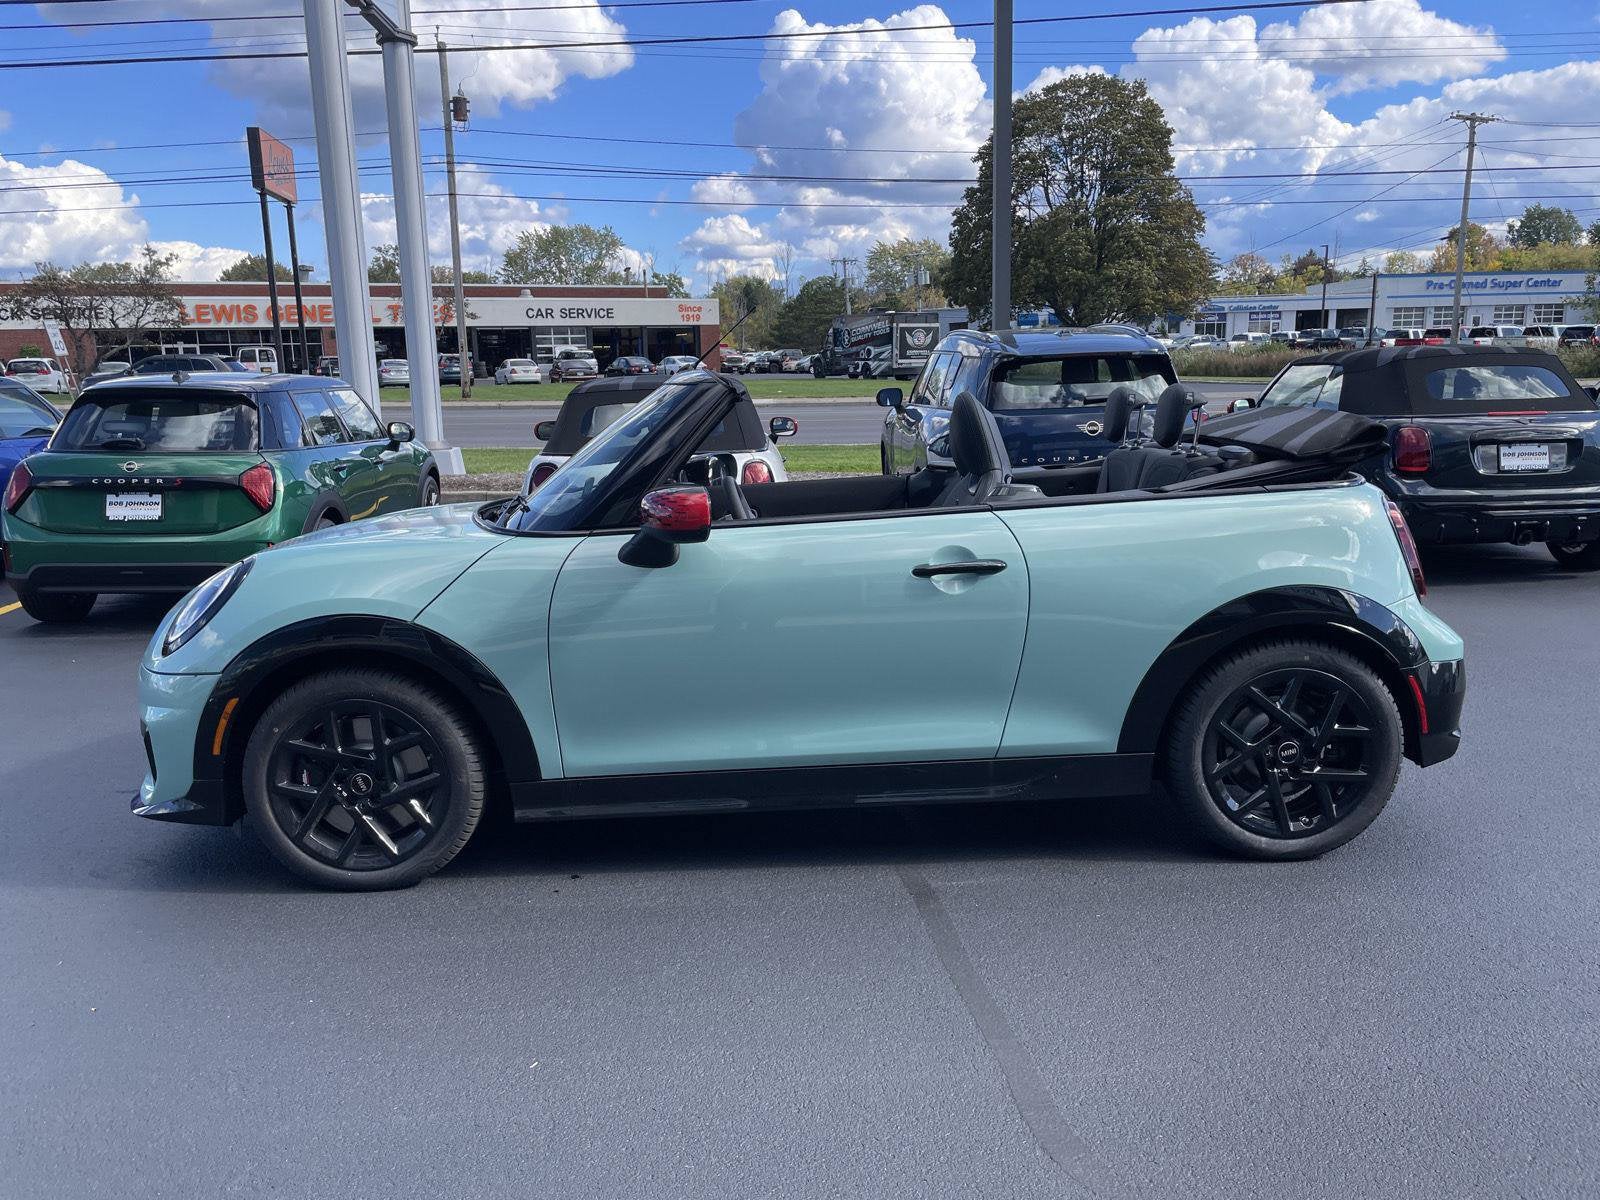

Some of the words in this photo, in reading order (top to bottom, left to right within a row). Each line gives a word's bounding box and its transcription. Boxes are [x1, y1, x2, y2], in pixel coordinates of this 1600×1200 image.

[1490, 278, 1523, 290] Super
[1526, 278, 1563, 288] Center
[525, 308, 555, 319] CAR
[559, 308, 615, 319] SERVICE
[678, 304, 703, 313] Since
[680, 313, 701, 322] 1919
[851, 319, 889, 336] CORNWELL
[851, 332, 872, 343] QUALITY
[873, 326, 890, 336] TOOLS
[54, 340, 66, 351] 40
[124, 500, 160, 508] JOHNSON
[1281, 747, 1297, 757] MINI
[355, 776, 368, 792] MINI
